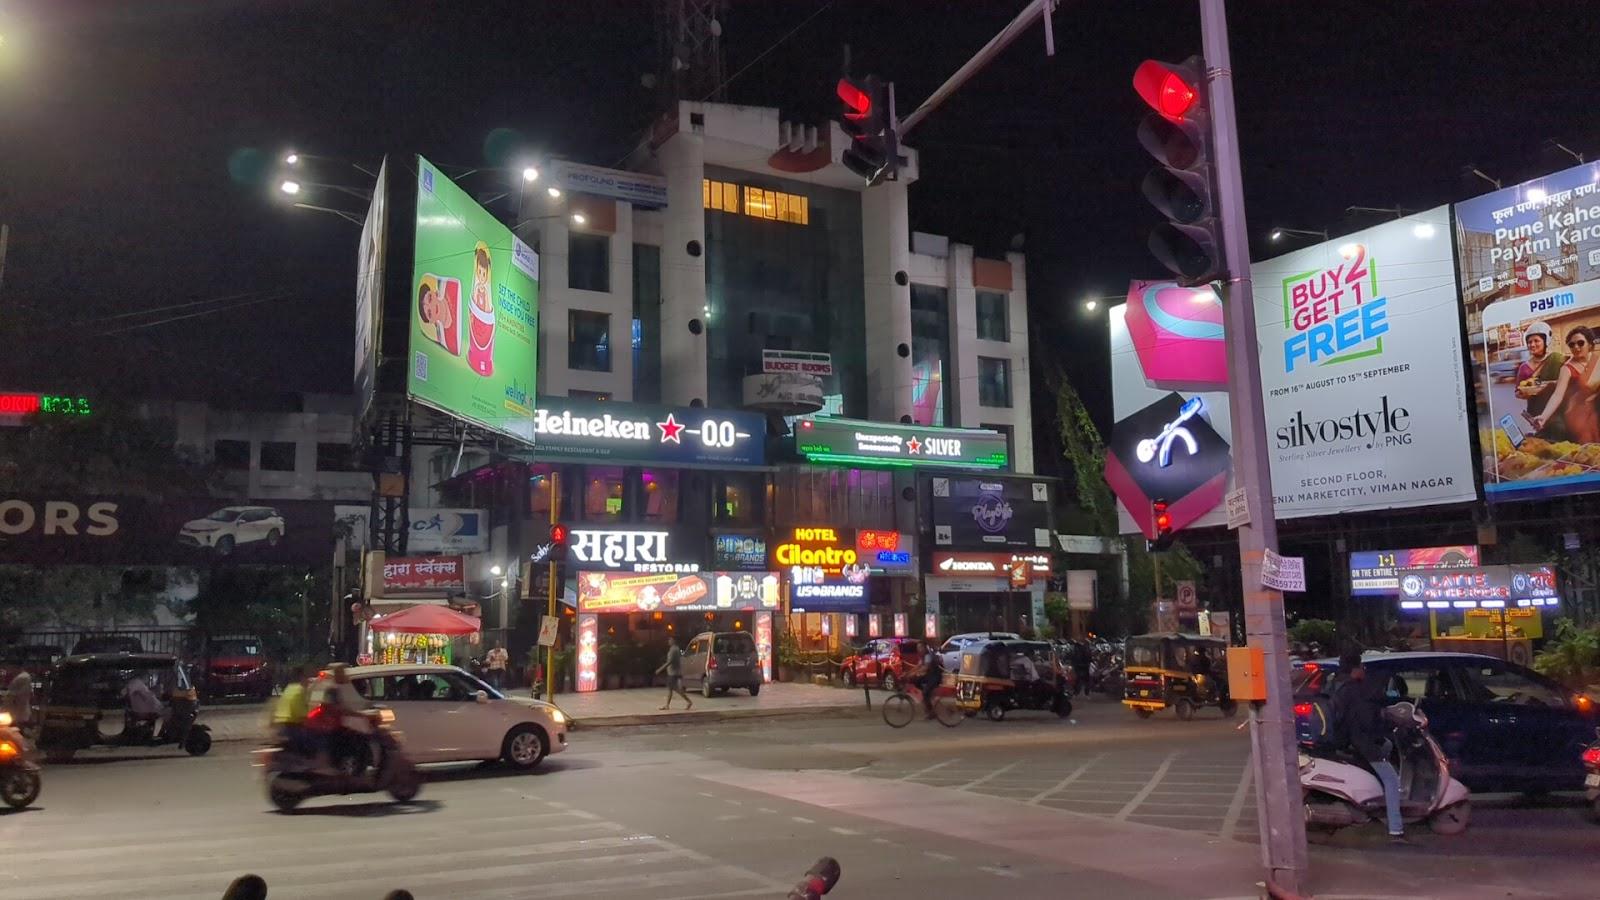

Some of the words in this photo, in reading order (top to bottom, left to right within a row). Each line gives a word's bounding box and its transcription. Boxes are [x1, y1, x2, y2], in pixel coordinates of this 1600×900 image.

[1495, 221, 1544, 244] Pune
[1548, 205, 1600, 230] Kahe
[1490, 237, 1551, 264] Paytm
[1292, 264, 1344, 309] BUY
[1343, 244, 1368, 284] 2
[1293, 289, 1344, 331] GET
[1351, 282, 1362, 305] 1
[1283, 296, 1390, 374] FREE
[1270, 387, 1290, 397] FROM
[1305, 379, 1335, 390] AUGUST
[1336, 376, 1347, 384] TO
[1363, 364, 1410, 379] SEPTEMBER
[1276, 395, 1411, 450] silvostyle
[925, 437, 961, 456] SILVER
[1385, 433, 1412, 447] PNG
[1306, 449, 1326, 459] Silver
[1297, 488, 1366, 502] MARKETCITY,
[1370, 482, 1407, 494] VIMAN
[1411, 477, 1453, 490] NAGAR
[1300, 475, 1342, 487] SECOND
[1346, 470, 1388, 483] FLOOR,
[0, 499, 119, 536] ORS
[795, 528, 838, 541] HOTEL
[570, 530, 669, 567] सहारा
[776, 544, 857, 565] Cilantro
[1361, 568, 1372, 577] THE
[1373, 567, 1393, 577] ENTIRE
[1430, 573, 1486, 586] LATTE
